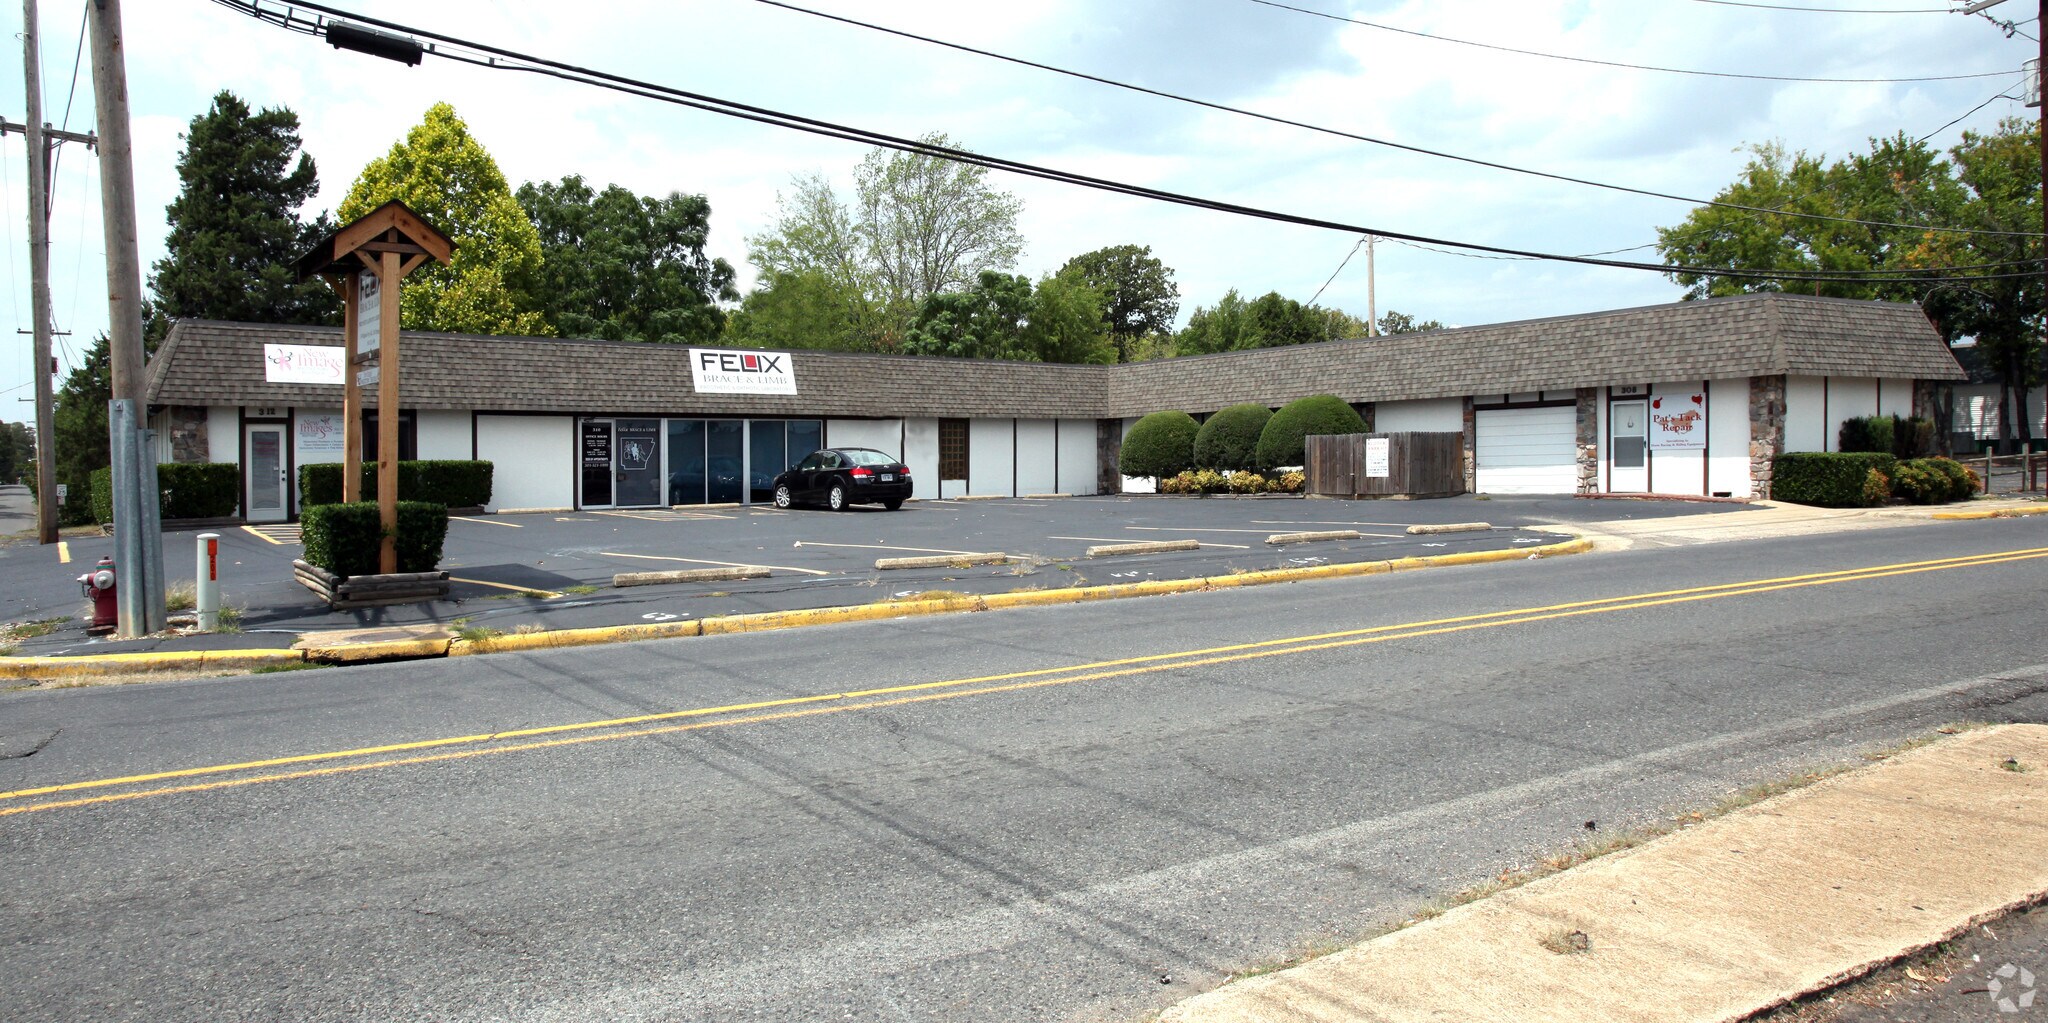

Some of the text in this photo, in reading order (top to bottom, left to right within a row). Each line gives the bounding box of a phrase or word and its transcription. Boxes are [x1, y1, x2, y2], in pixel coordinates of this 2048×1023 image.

[303, 347, 329, 358] New
[700, 352, 783, 374] FELIX
[703, 374, 788, 385] BRACE & LIMB
[1621, 386, 1637, 394] 308
[258, 407, 276, 416] 312
[1653, 412, 1702, 423] Pat's Tack
[1662, 423, 1694, 433] Repair
